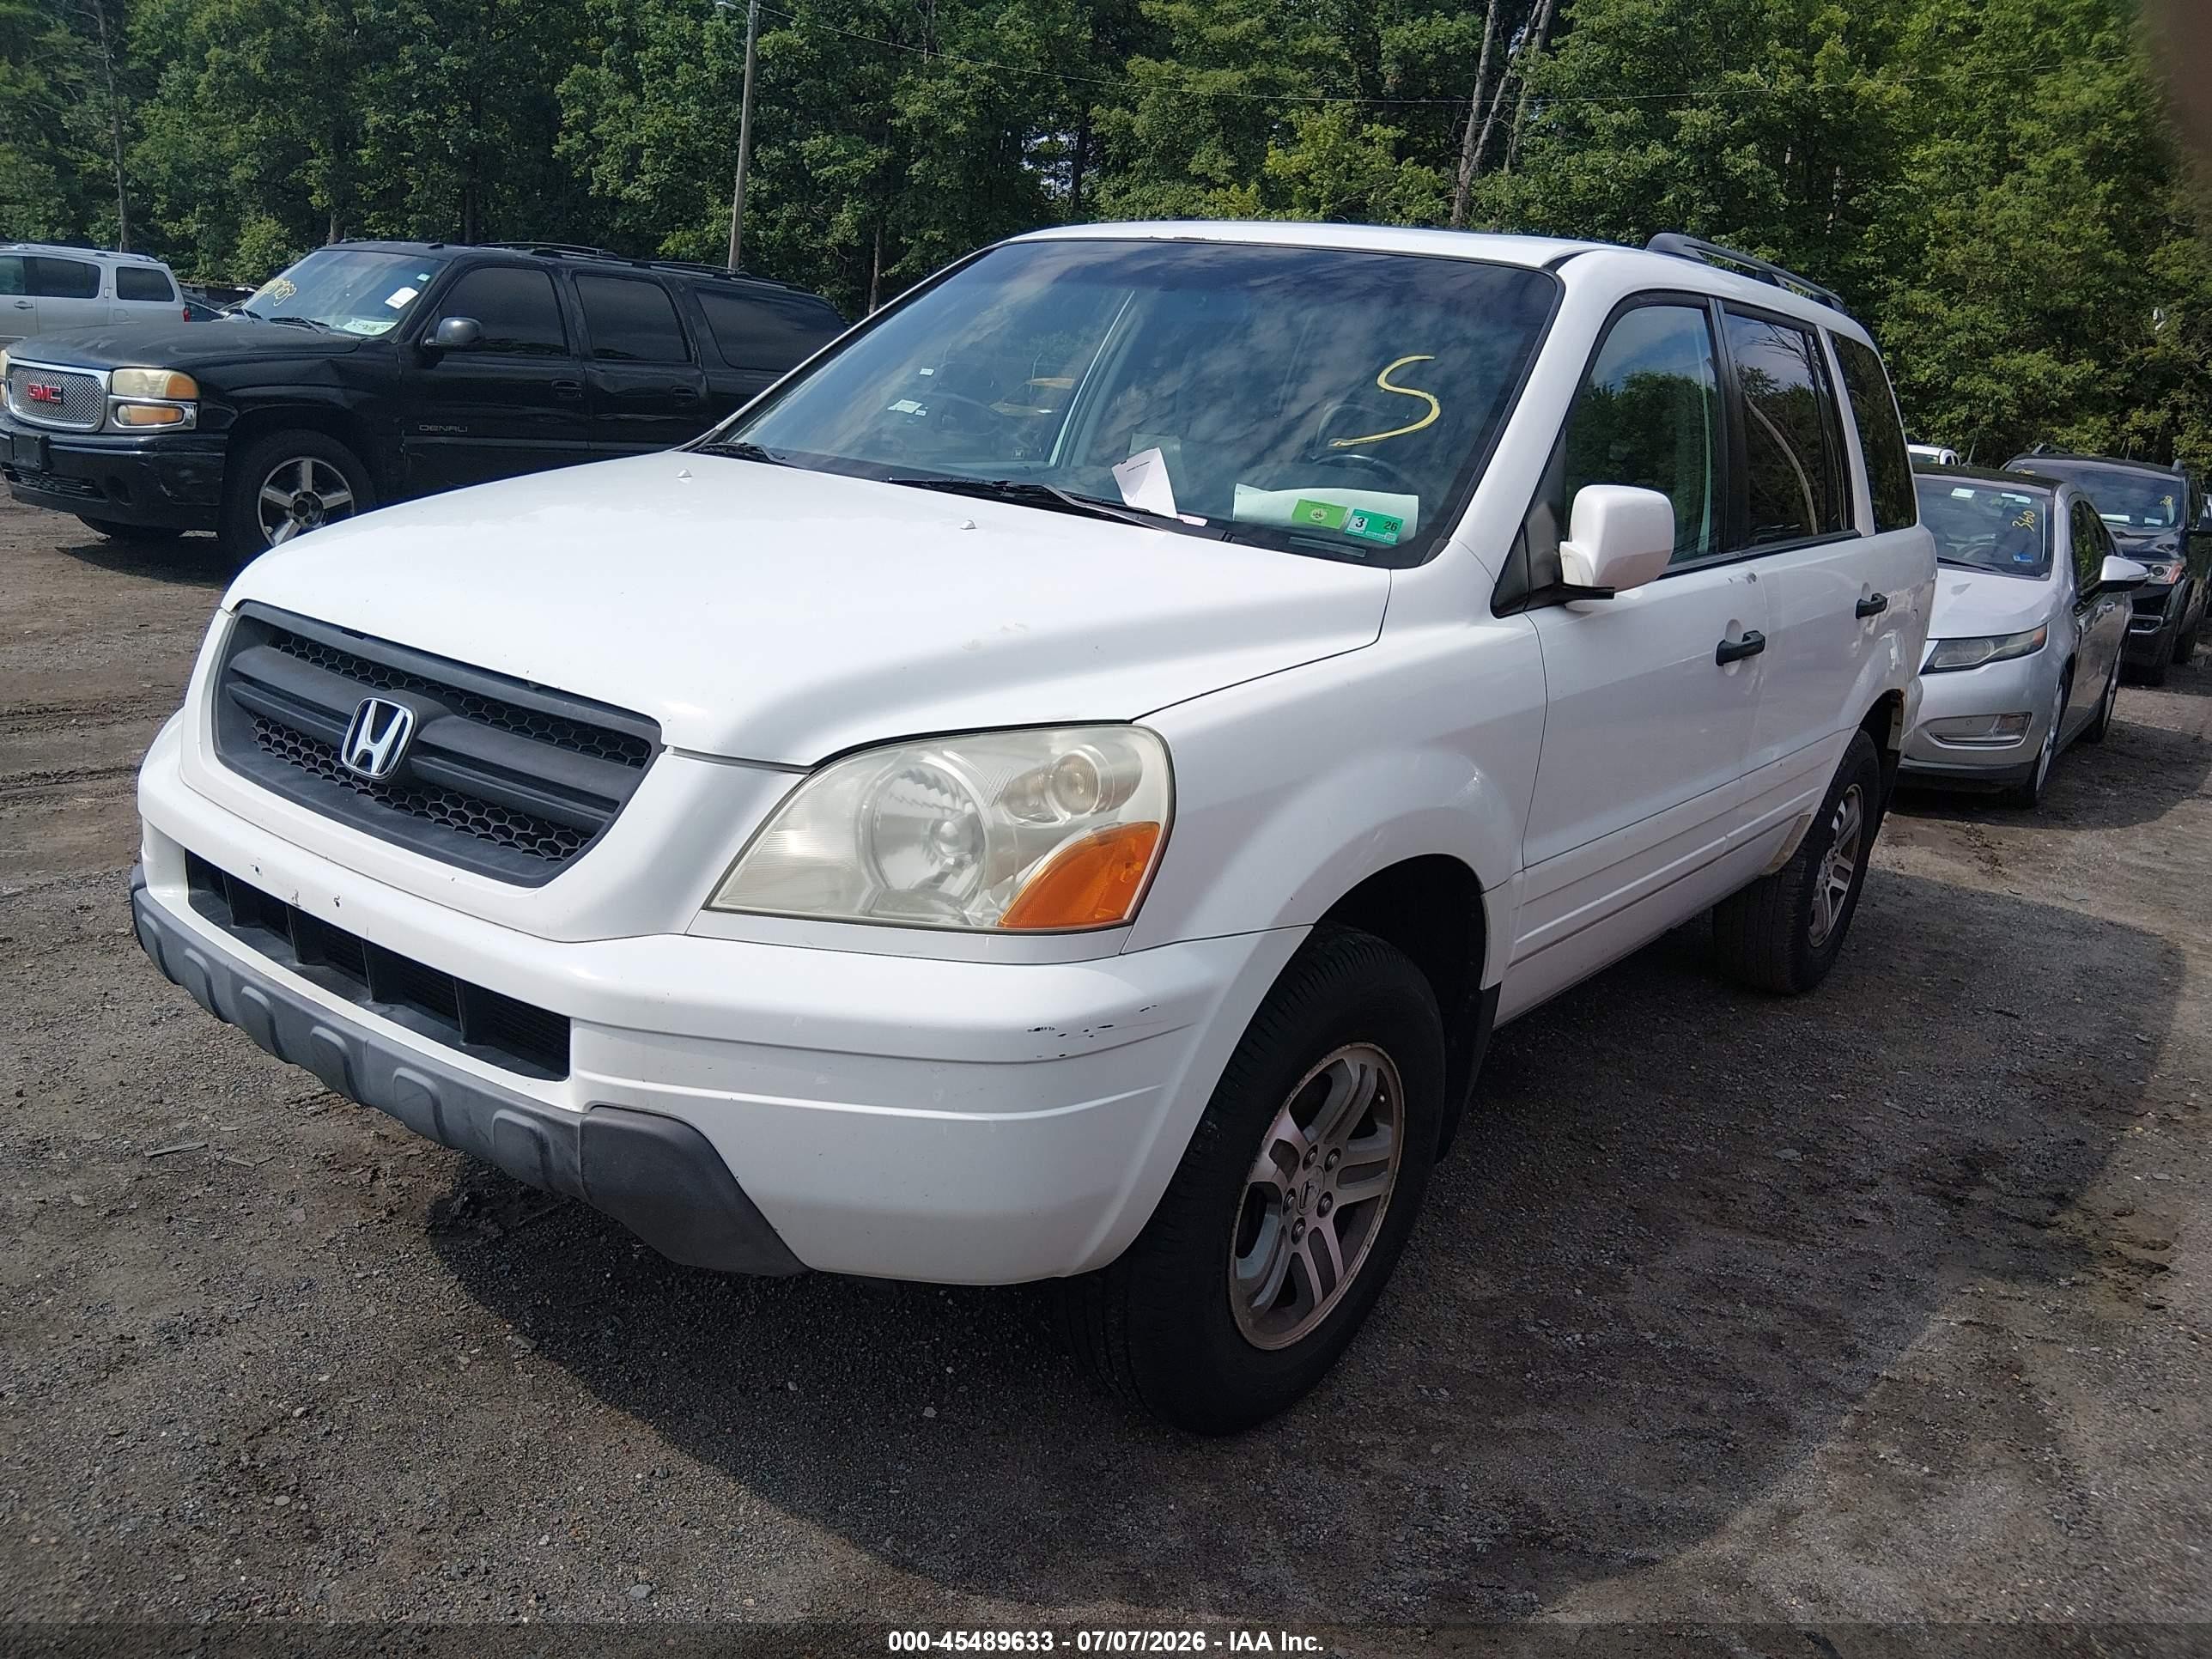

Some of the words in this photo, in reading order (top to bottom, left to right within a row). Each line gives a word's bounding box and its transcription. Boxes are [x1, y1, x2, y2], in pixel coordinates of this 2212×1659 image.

[27, 383, 62, 404] GMC
[418, 424, 468, 433] DENALI
[1355, 517, 1365, 528] 3
[1383, 520, 1399, 532] 26
